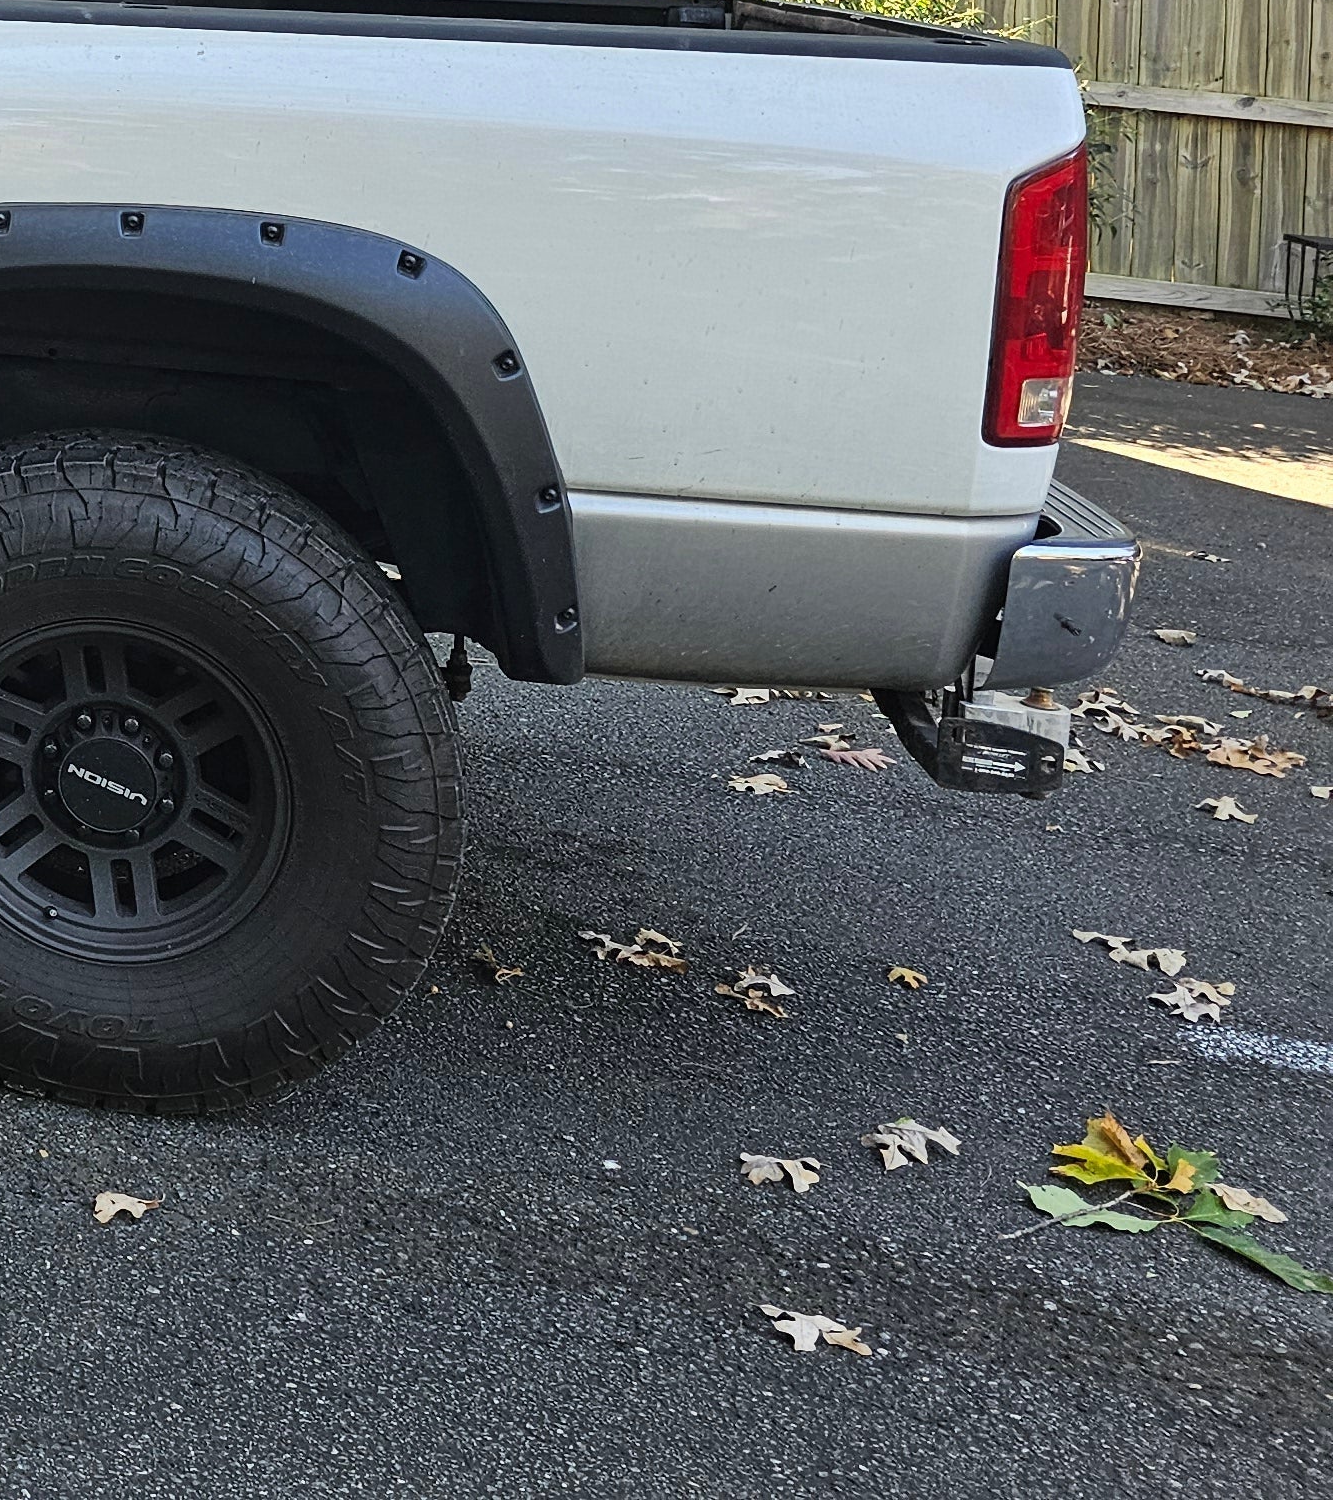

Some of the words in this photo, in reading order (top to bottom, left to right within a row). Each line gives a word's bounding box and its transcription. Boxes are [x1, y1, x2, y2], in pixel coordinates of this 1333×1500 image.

[113, 557, 329, 687] COUNTRY
[67, 763, 148, 806] VISION
[11, 995, 163, 1043] TOYO
